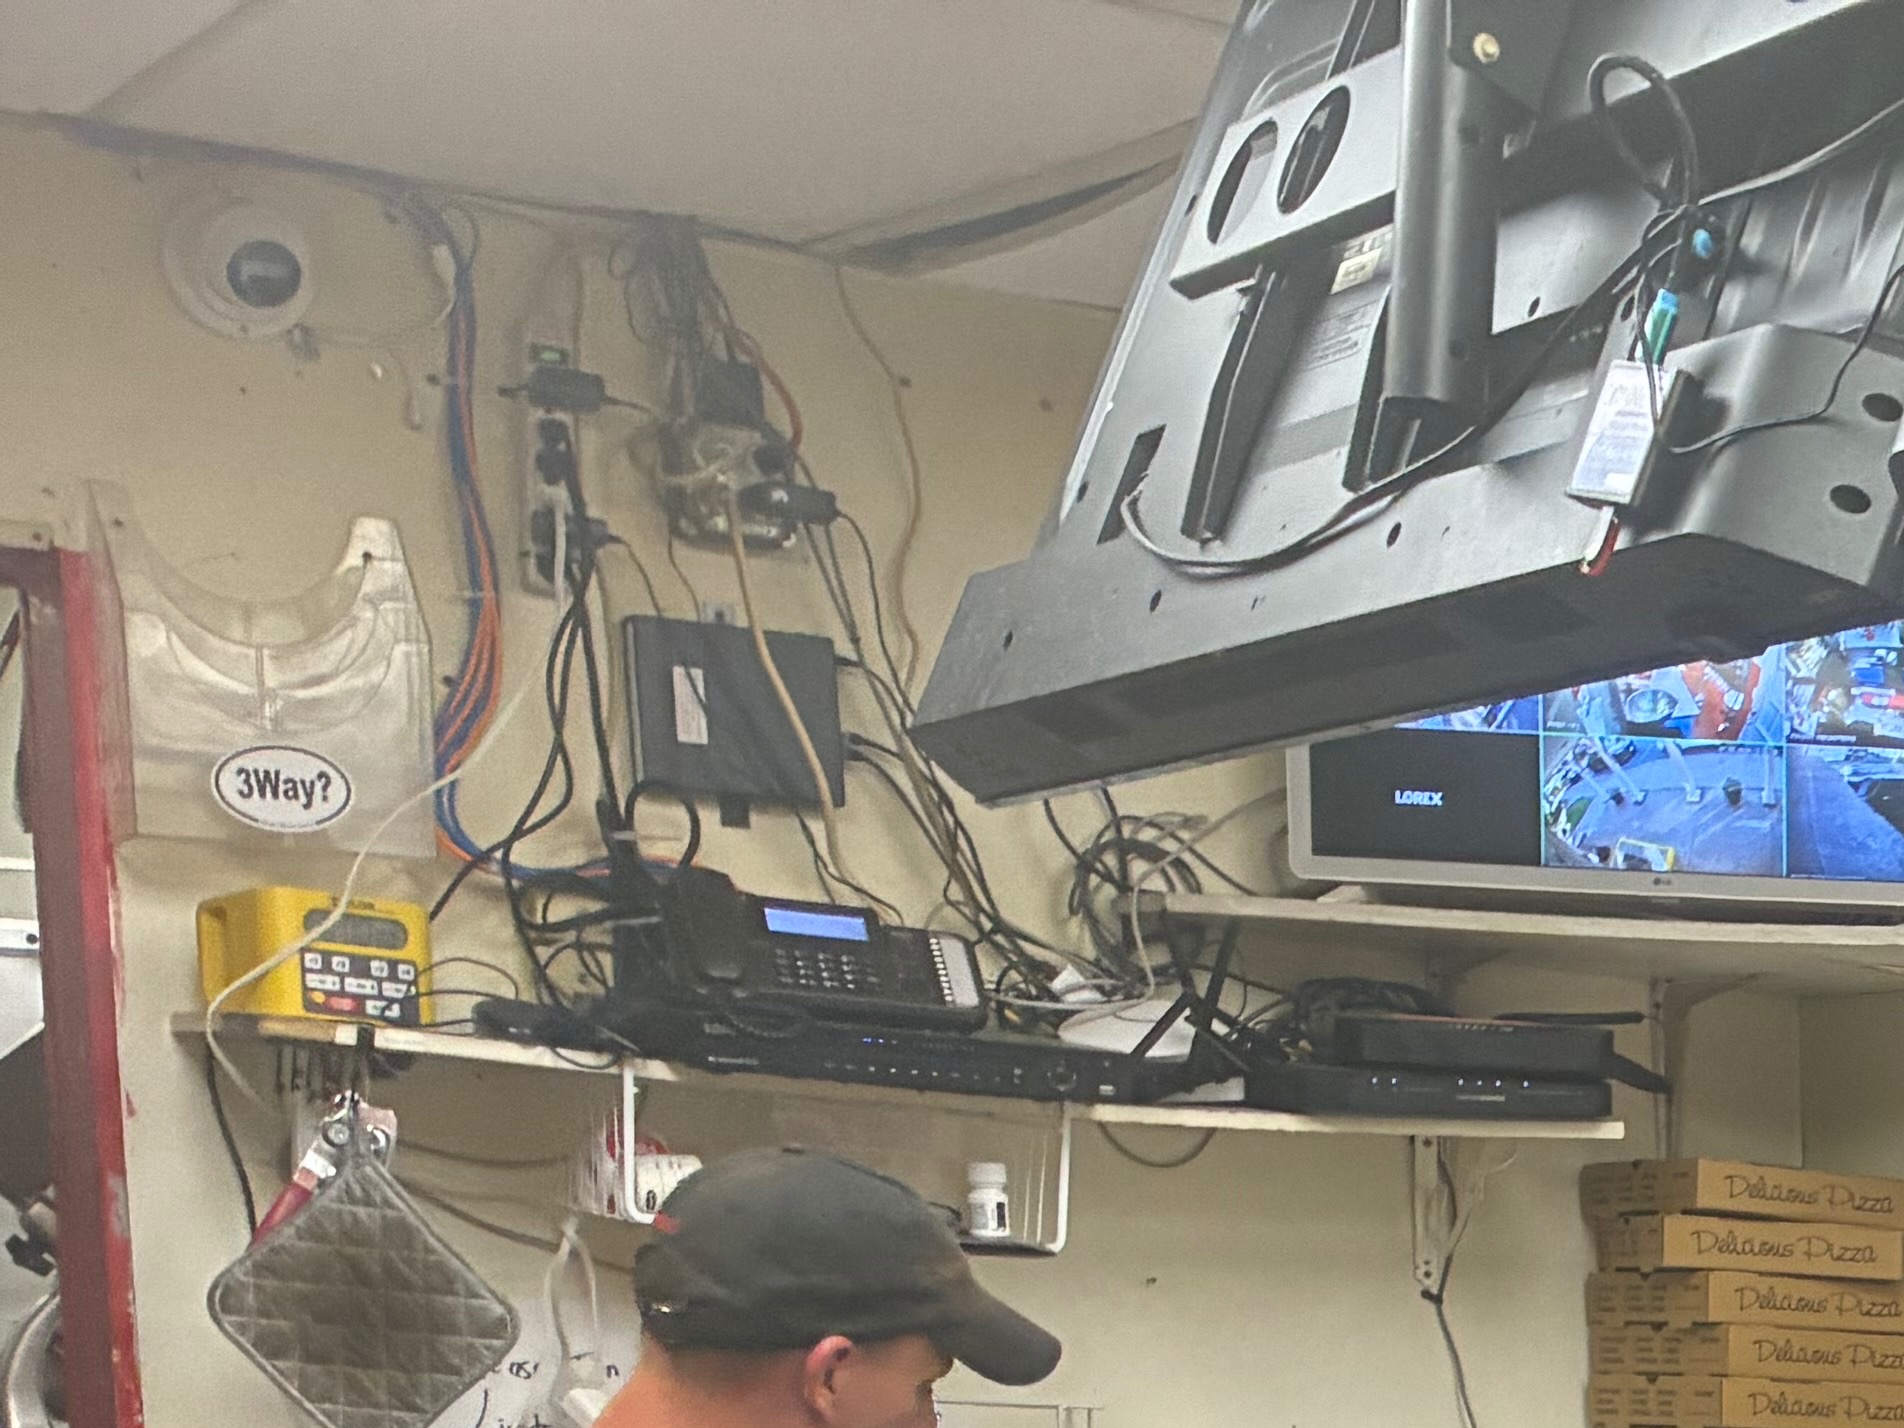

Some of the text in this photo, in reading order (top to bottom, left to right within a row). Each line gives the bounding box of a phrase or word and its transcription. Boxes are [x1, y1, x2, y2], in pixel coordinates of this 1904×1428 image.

[235, 767, 332, 811] 3Way?
[1394, 789, 1444, 806] LOREX
[1726, 1174, 1894, 1215] Delicious Pizza
[1692, 1230, 1878, 1264] Delicious Pizza
[1735, 1287, 1903, 1319] Delicious Pizza
[1753, 1339, 1842, 1367] Delicious
[1748, 1392, 1838, 1419] Delicious
